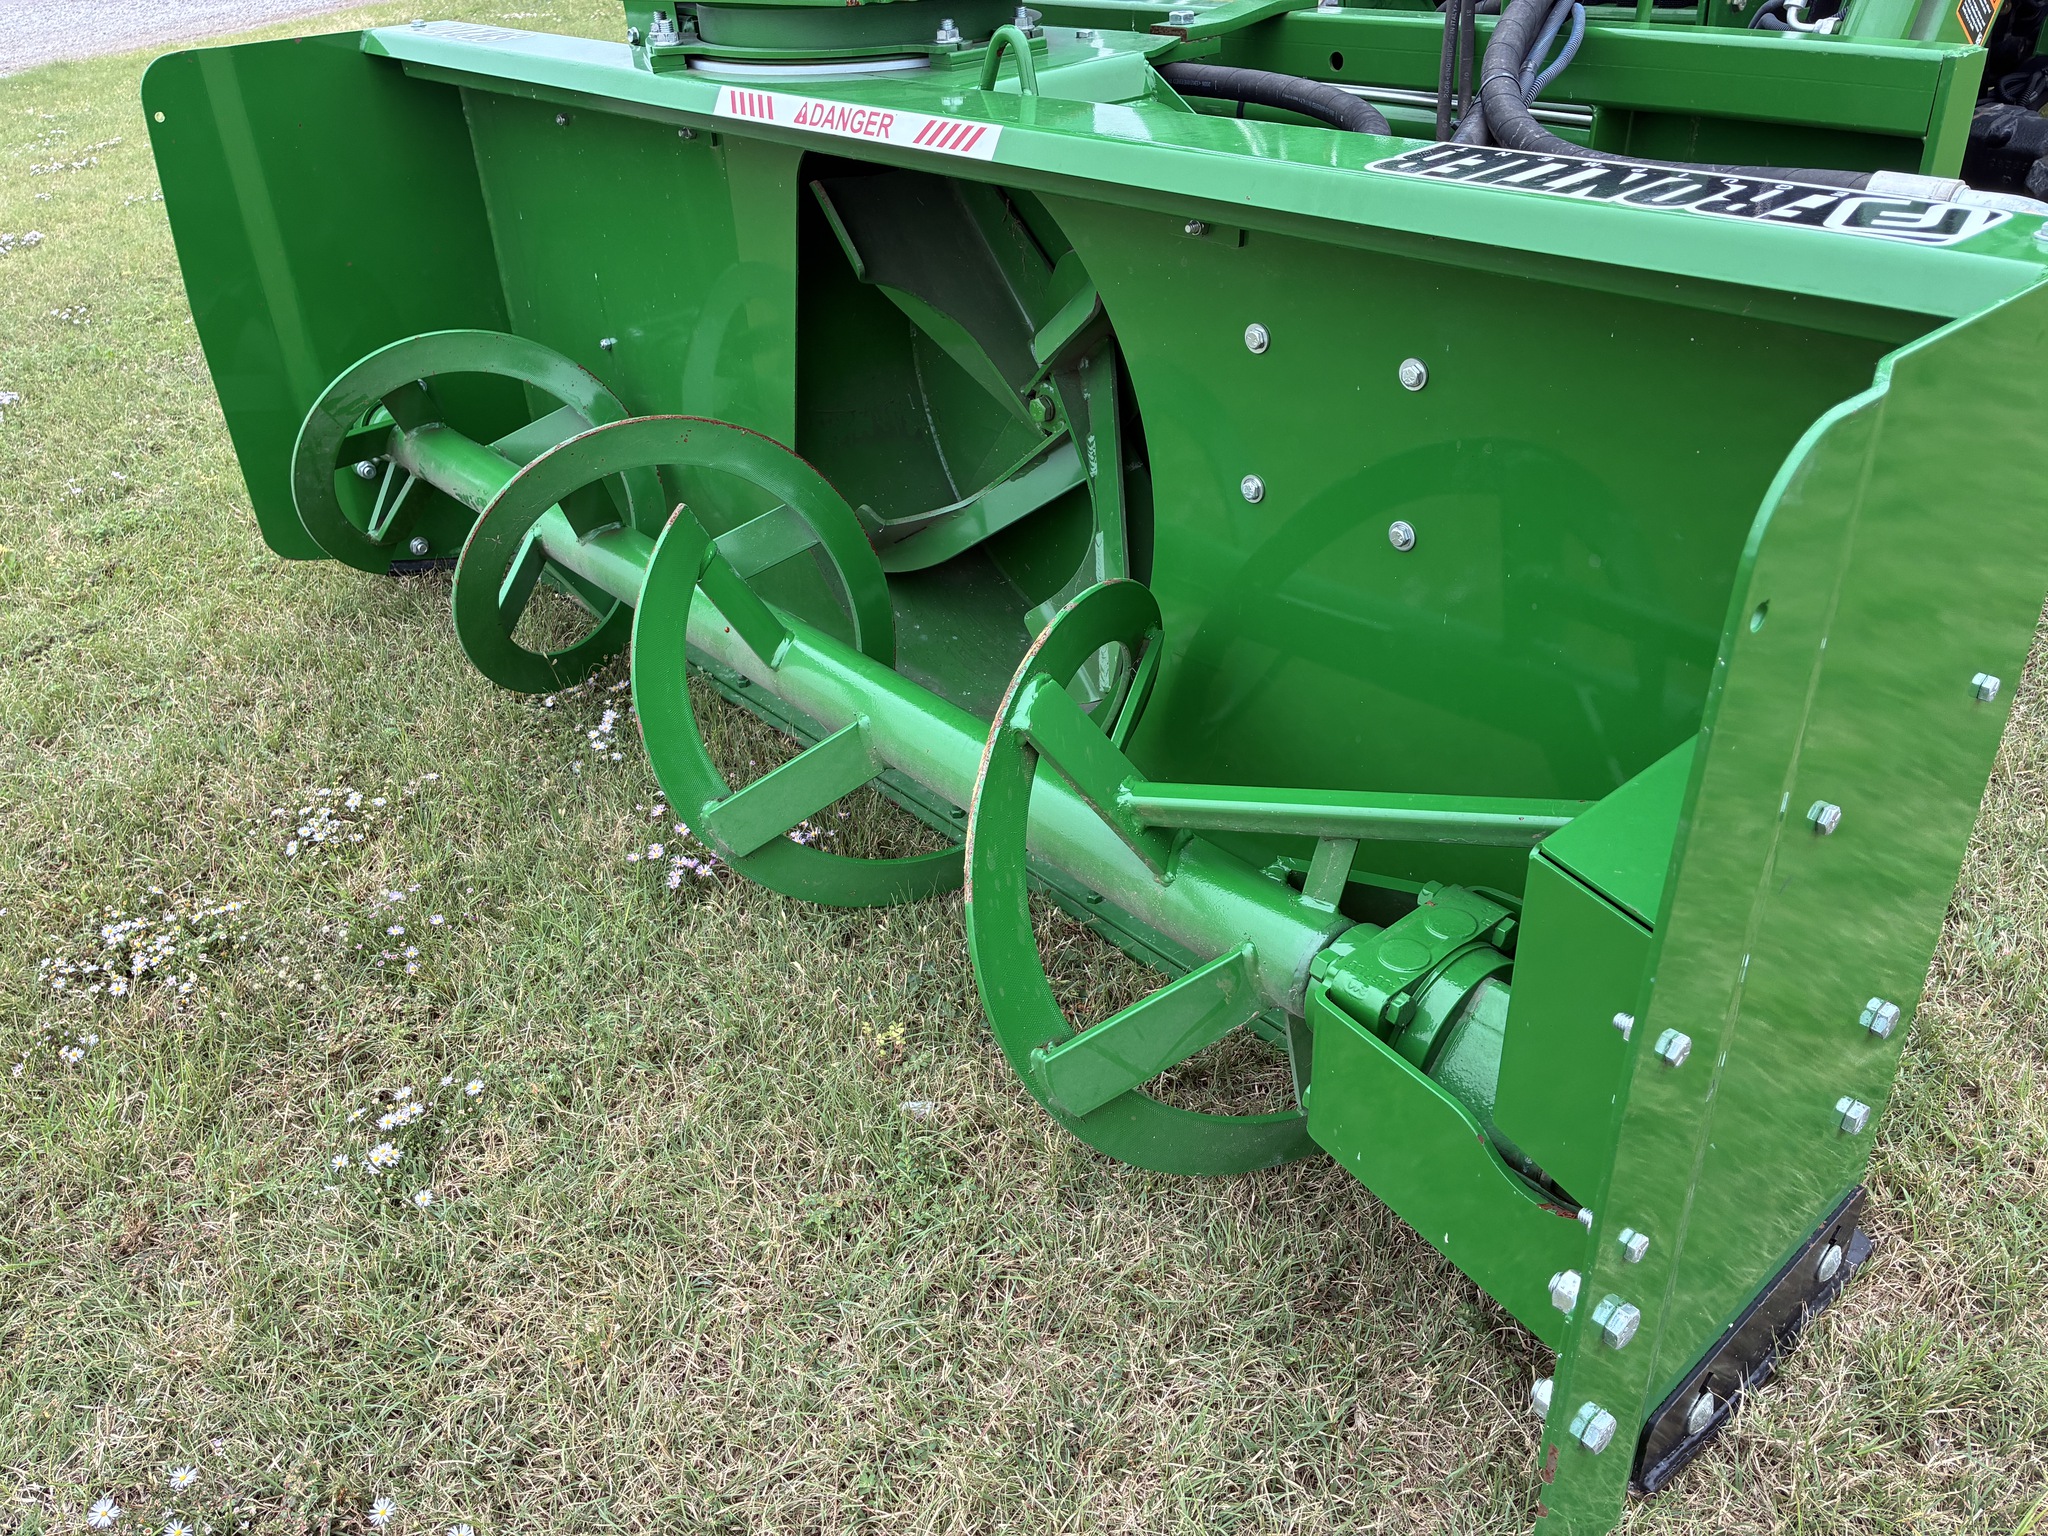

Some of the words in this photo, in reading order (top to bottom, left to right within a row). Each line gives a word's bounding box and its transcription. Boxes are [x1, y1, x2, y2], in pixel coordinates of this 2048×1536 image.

[808, 103, 894, 139] DANGER
[1372, 150, 1841, 229] FRONTIER
[1454, 146, 1850, 198] EQUIPMENT
